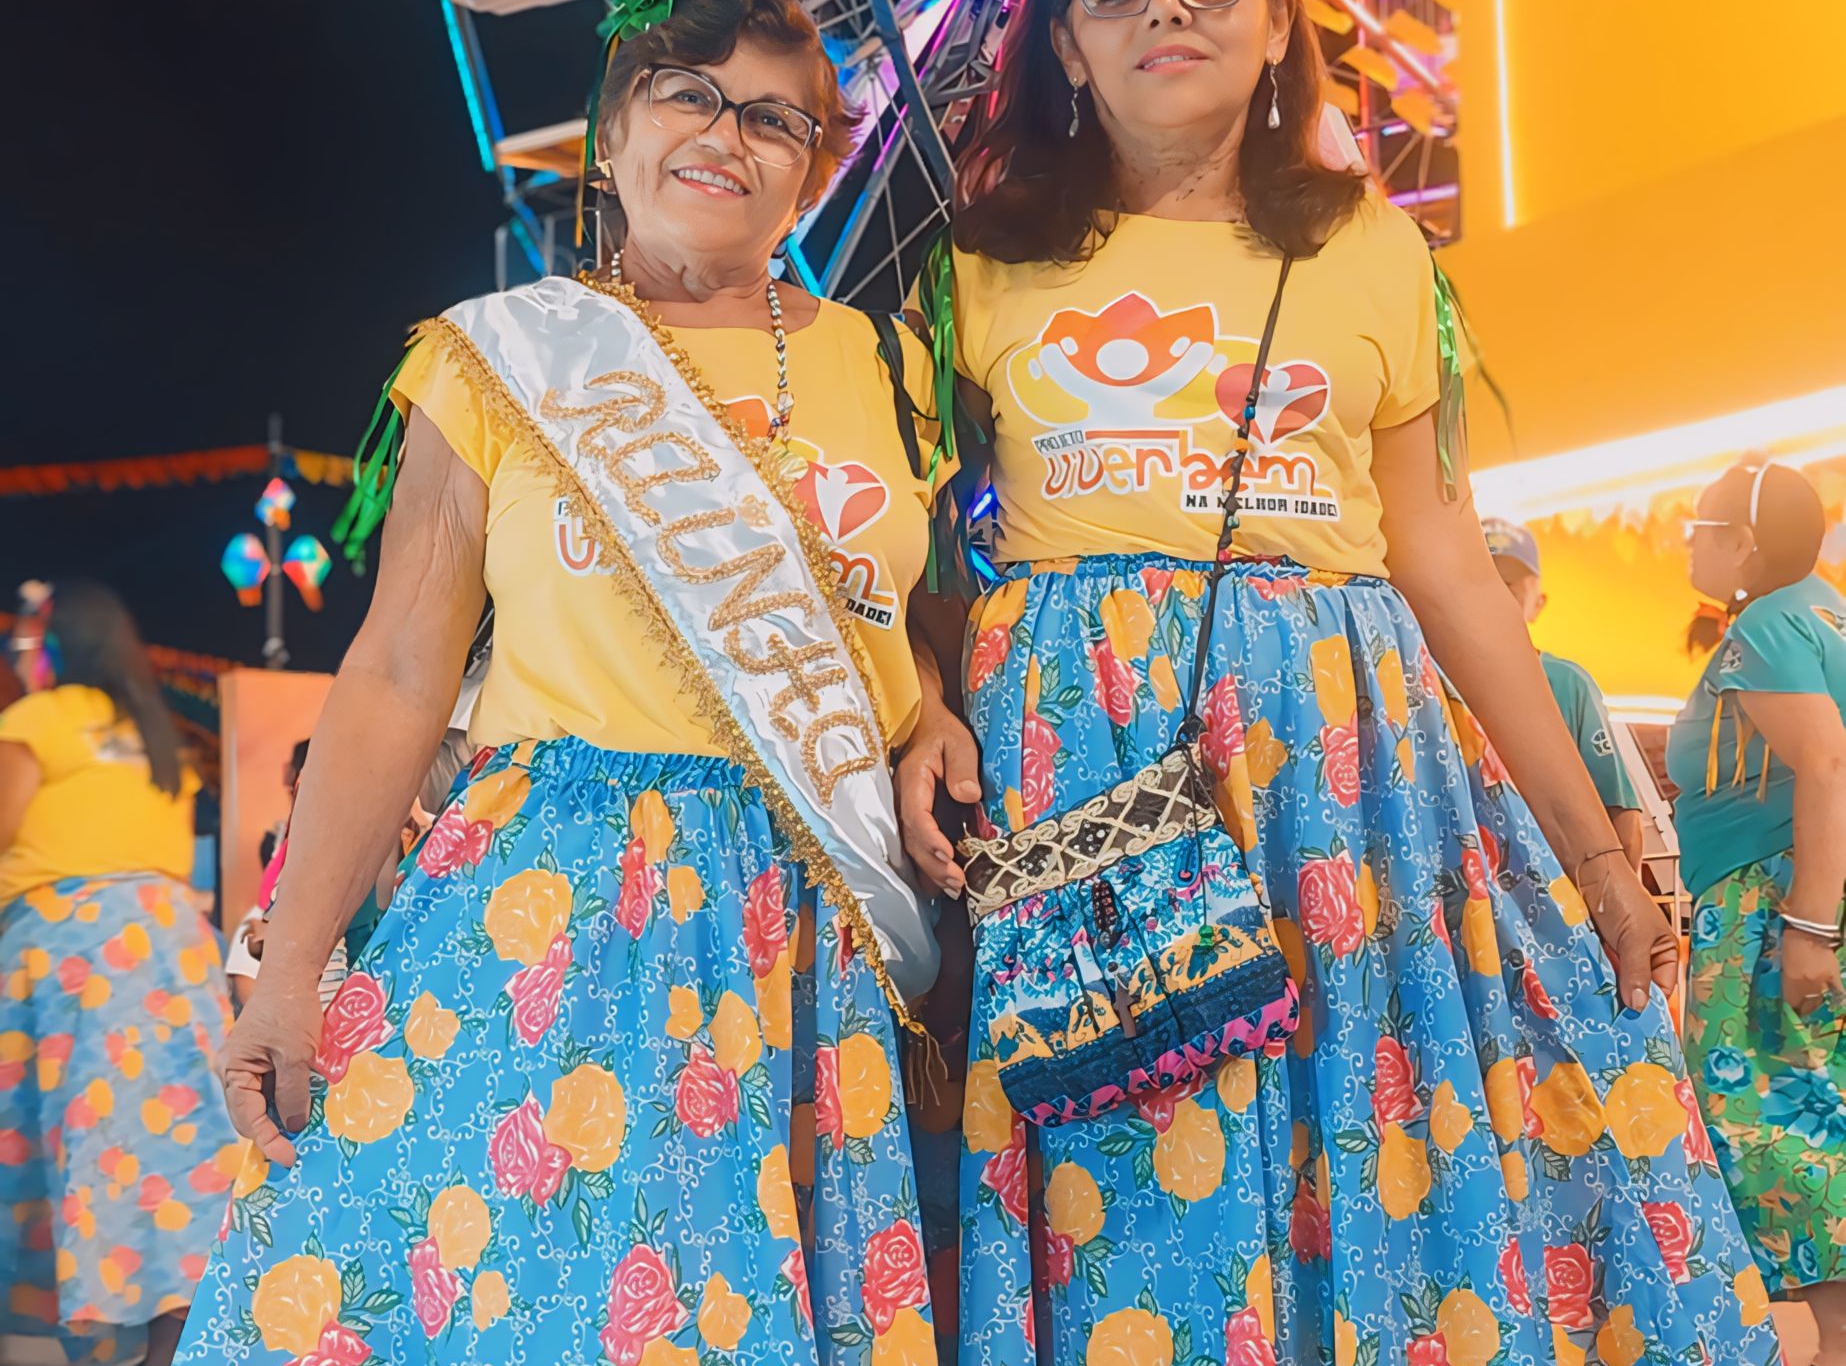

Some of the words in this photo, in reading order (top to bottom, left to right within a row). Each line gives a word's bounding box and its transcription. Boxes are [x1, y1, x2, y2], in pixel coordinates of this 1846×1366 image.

[1034, 429, 1084, 454] PROJETO
[1186, 494, 1208, 508] NA
[845, 598, 892, 626] DADE!
